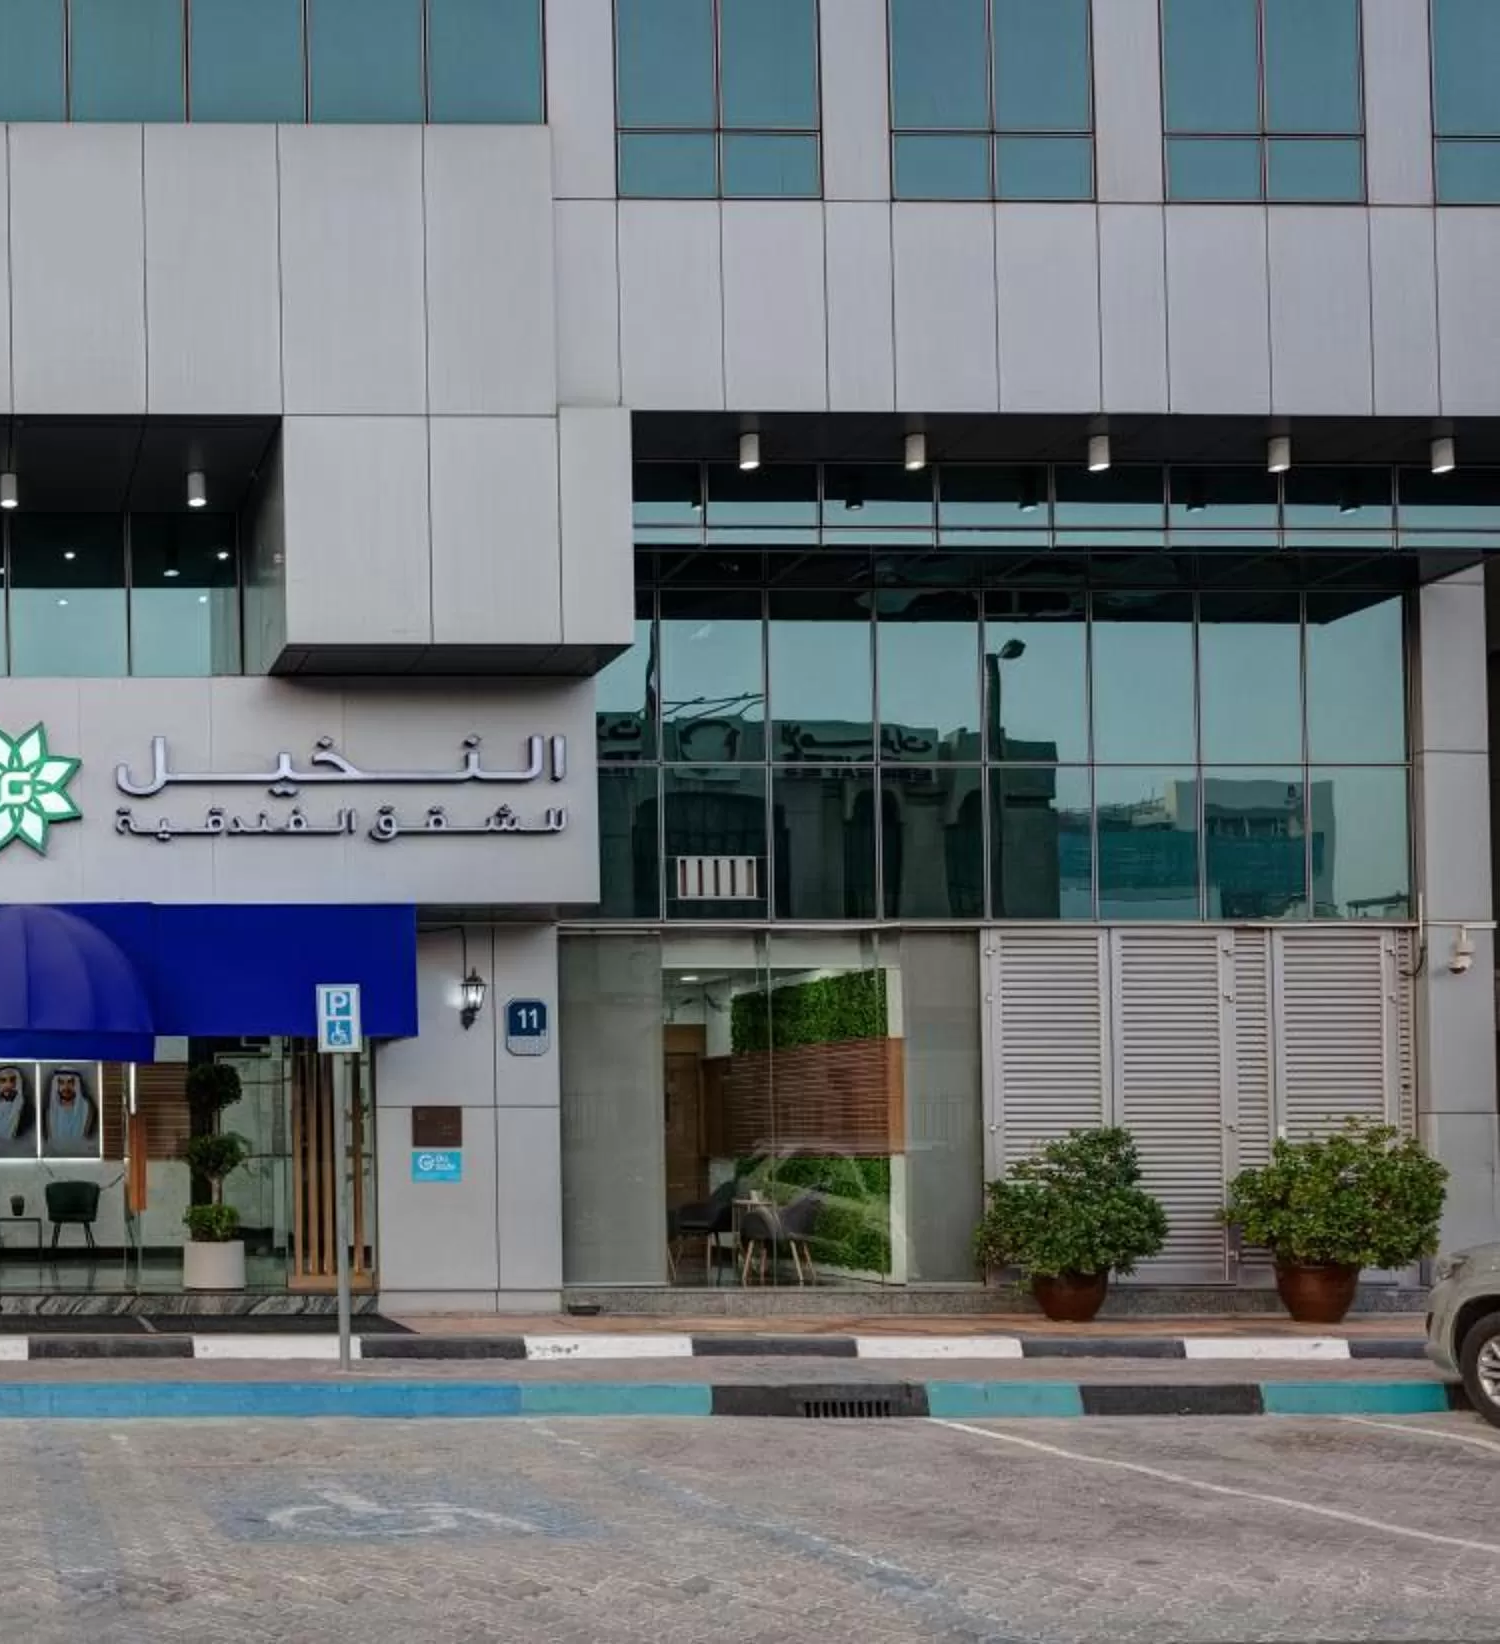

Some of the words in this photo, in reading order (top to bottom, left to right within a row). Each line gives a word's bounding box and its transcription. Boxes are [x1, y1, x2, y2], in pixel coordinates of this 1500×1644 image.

[115, 735, 567, 798] النخيل
[115, 805, 357, 842] الفندقية
[369, 804, 568, 842] للشقق
[329, 992, 349, 1016] P
[517, 1008, 539, 1029] 11
